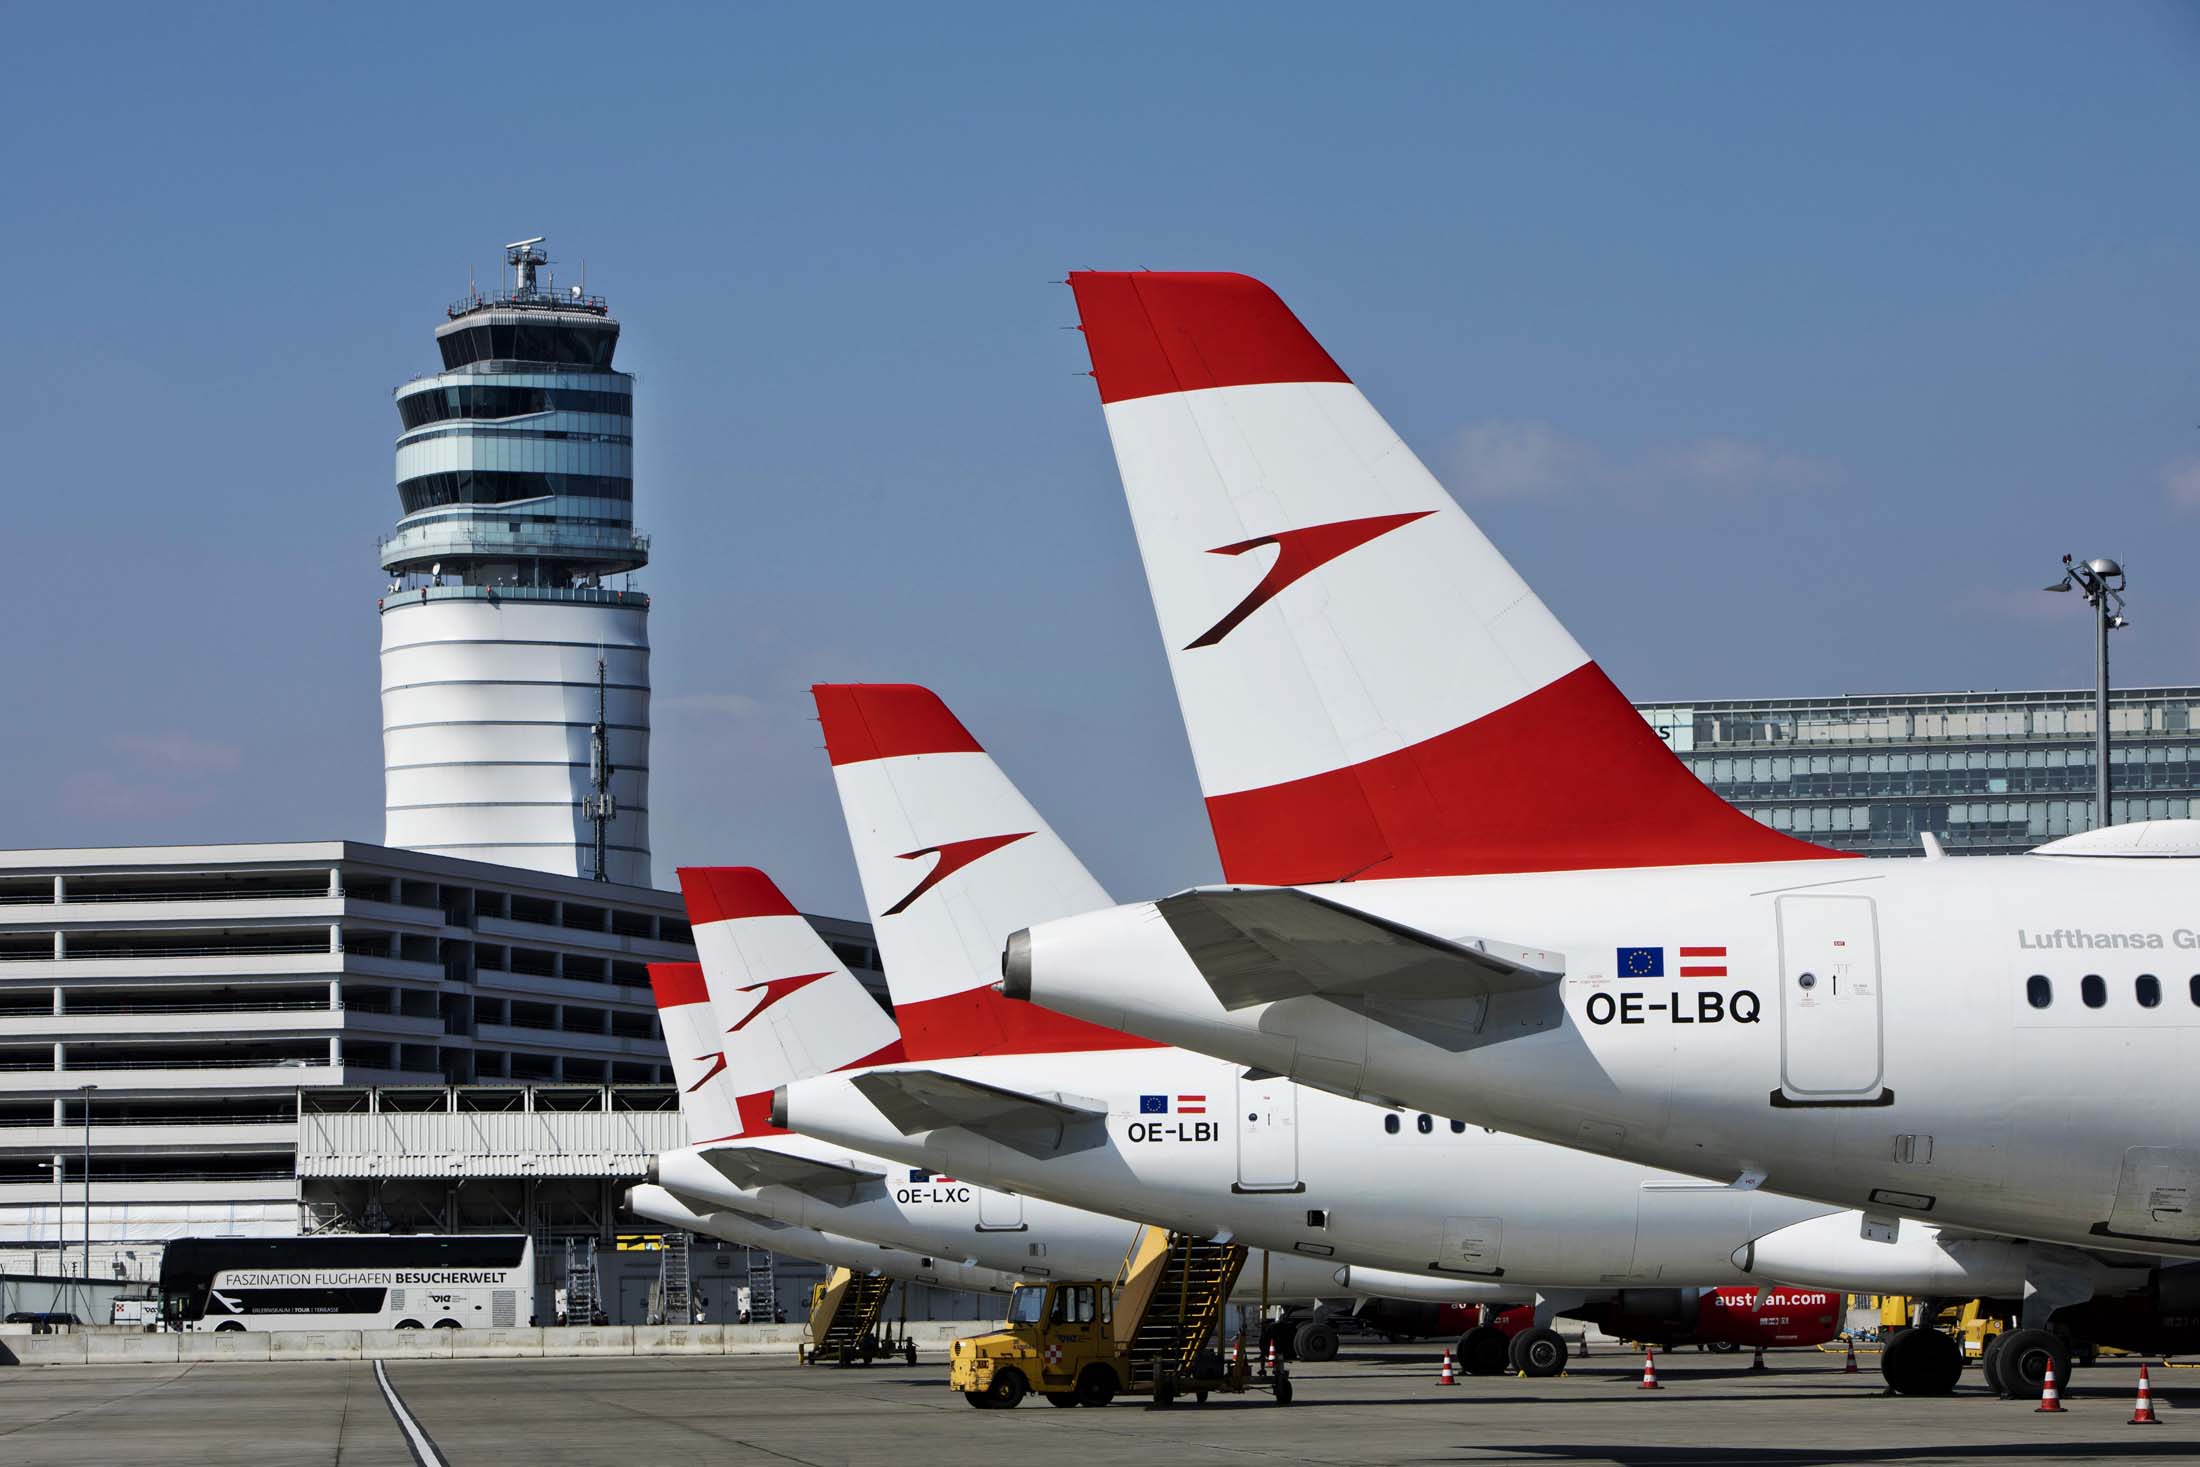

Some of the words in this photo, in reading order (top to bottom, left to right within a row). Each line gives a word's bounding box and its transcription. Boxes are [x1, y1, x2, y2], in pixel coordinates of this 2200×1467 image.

[2018, 929, 2163, 949] Lufthansa
[2172, 929, 2200, 949] G
[1586, 990, 1761, 1025] OE-LBQ
[1128, 1122, 1219, 1143] OE-LBI
[897, 1188, 970, 1203] OE-LXC
[226, 1274, 311, 1286] FASZINATION
[315, 1273, 392, 1284] FLUGHAFEN
[395, 1272, 507, 1284] BESUCHERWELT
[1715, 1293, 1826, 1307] austan.com
